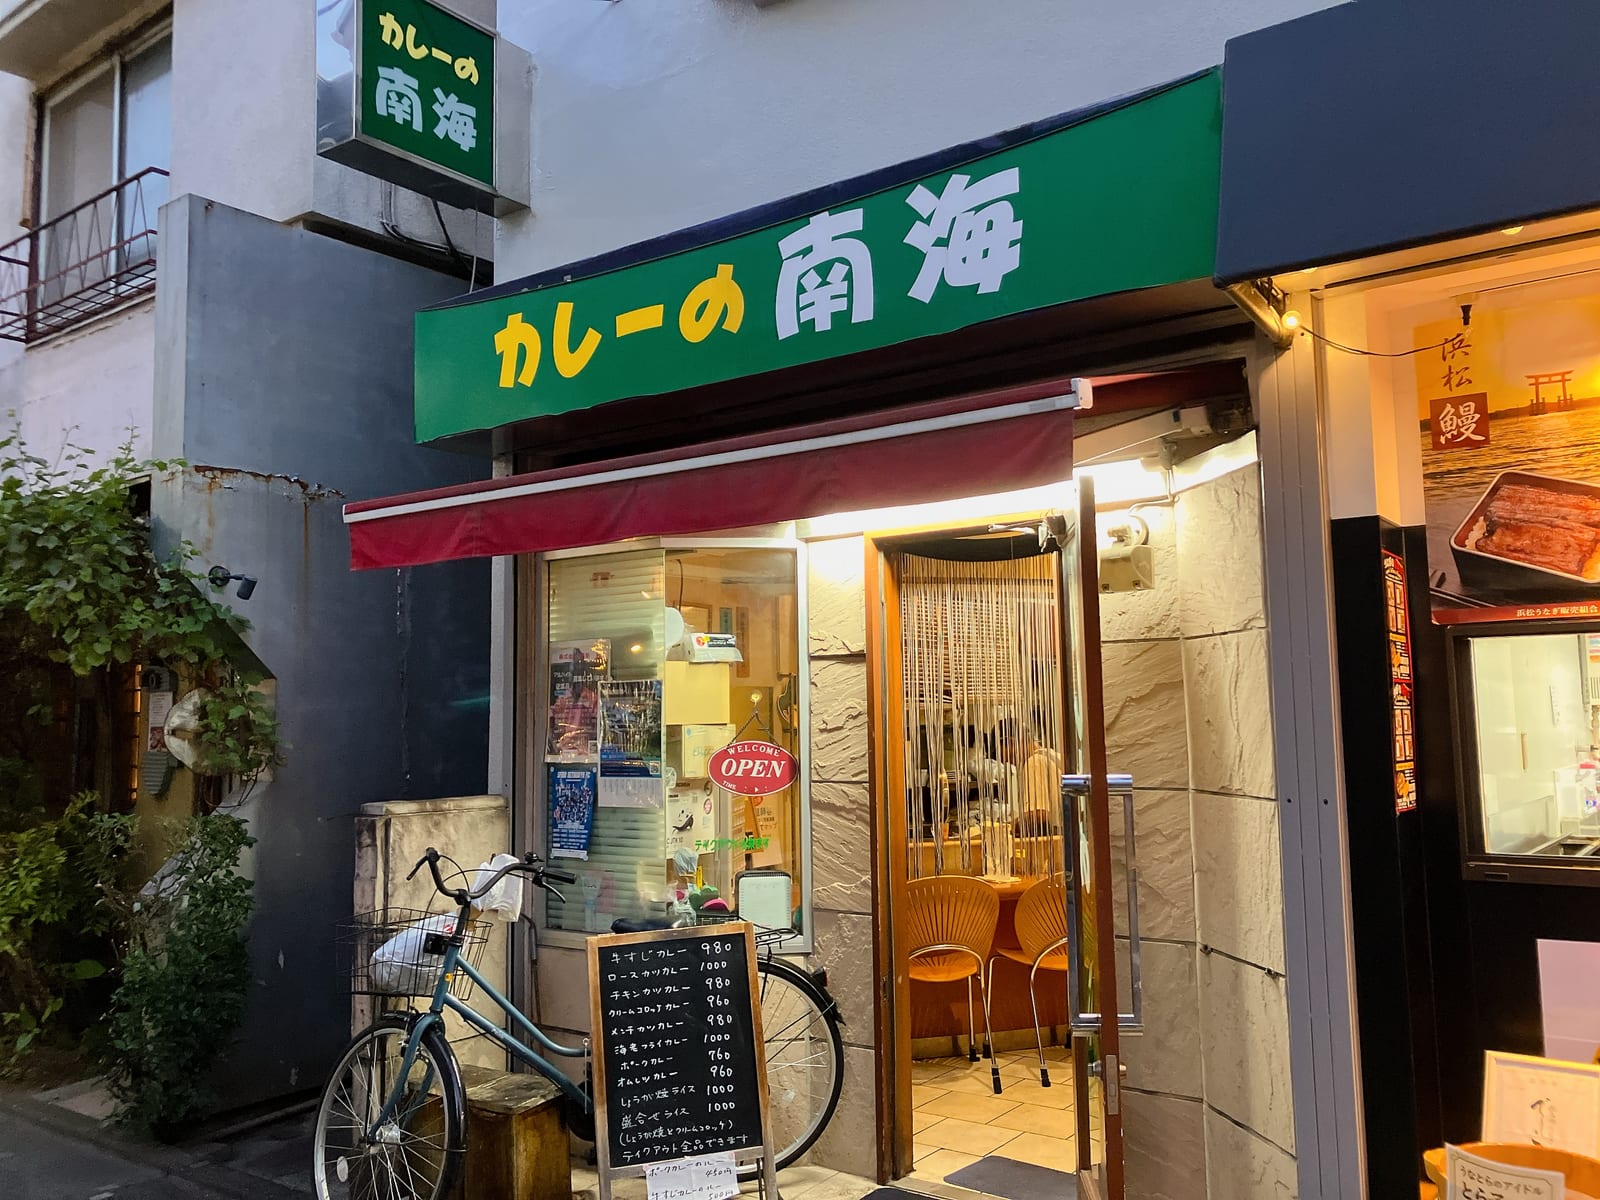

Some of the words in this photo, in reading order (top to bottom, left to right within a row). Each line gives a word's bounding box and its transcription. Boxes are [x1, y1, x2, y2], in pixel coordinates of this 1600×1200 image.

[378, 12, 479, 86] カレーの
[375, 66, 478, 152] 南海
[1441, 331, 1473, 393] 浜松
[1439, 400, 1486, 445] 鰻
[1516, 604, 1599, 617] 浜松うなぎ販売組合
[727, 744, 781, 757] WELCOME
[720, 758, 787, 778] OPEN
[722, 780, 737, 790] TIME
[610, 948, 688, 964] 牛すじカレー
[700, 940, 732, 955] 980
[607, 966, 690, 982] ロースカツカレー
[699, 960, 728, 972] 1000
[609, 985, 692, 1001] チキンカツカレー
[705, 976, 732, 990] 980
[608, 1001, 691, 1018] クリームコロッケカレー
[706, 994, 730, 1009] 960
[610, 1020, 684, 1037] メンチカツカレー
[706, 1013, 733, 1027] 980
[613, 1037, 689, 1056] 海老フライカレー
[703, 1032, 731, 1044] 1000
[620, 1056, 674, 1071] ポークカレー
[707, 1049, 731, 1062] 760
[616, 1071, 679, 1088] オムレツカレー
[709, 1065, 733, 1079] 960
[620, 1084, 697, 1108] しょうが焼ライス
[706, 1084, 734, 1096] 1000
[620, 1107, 691, 1130] 盛合せライス
[708, 1102, 736, 1113] 1000
